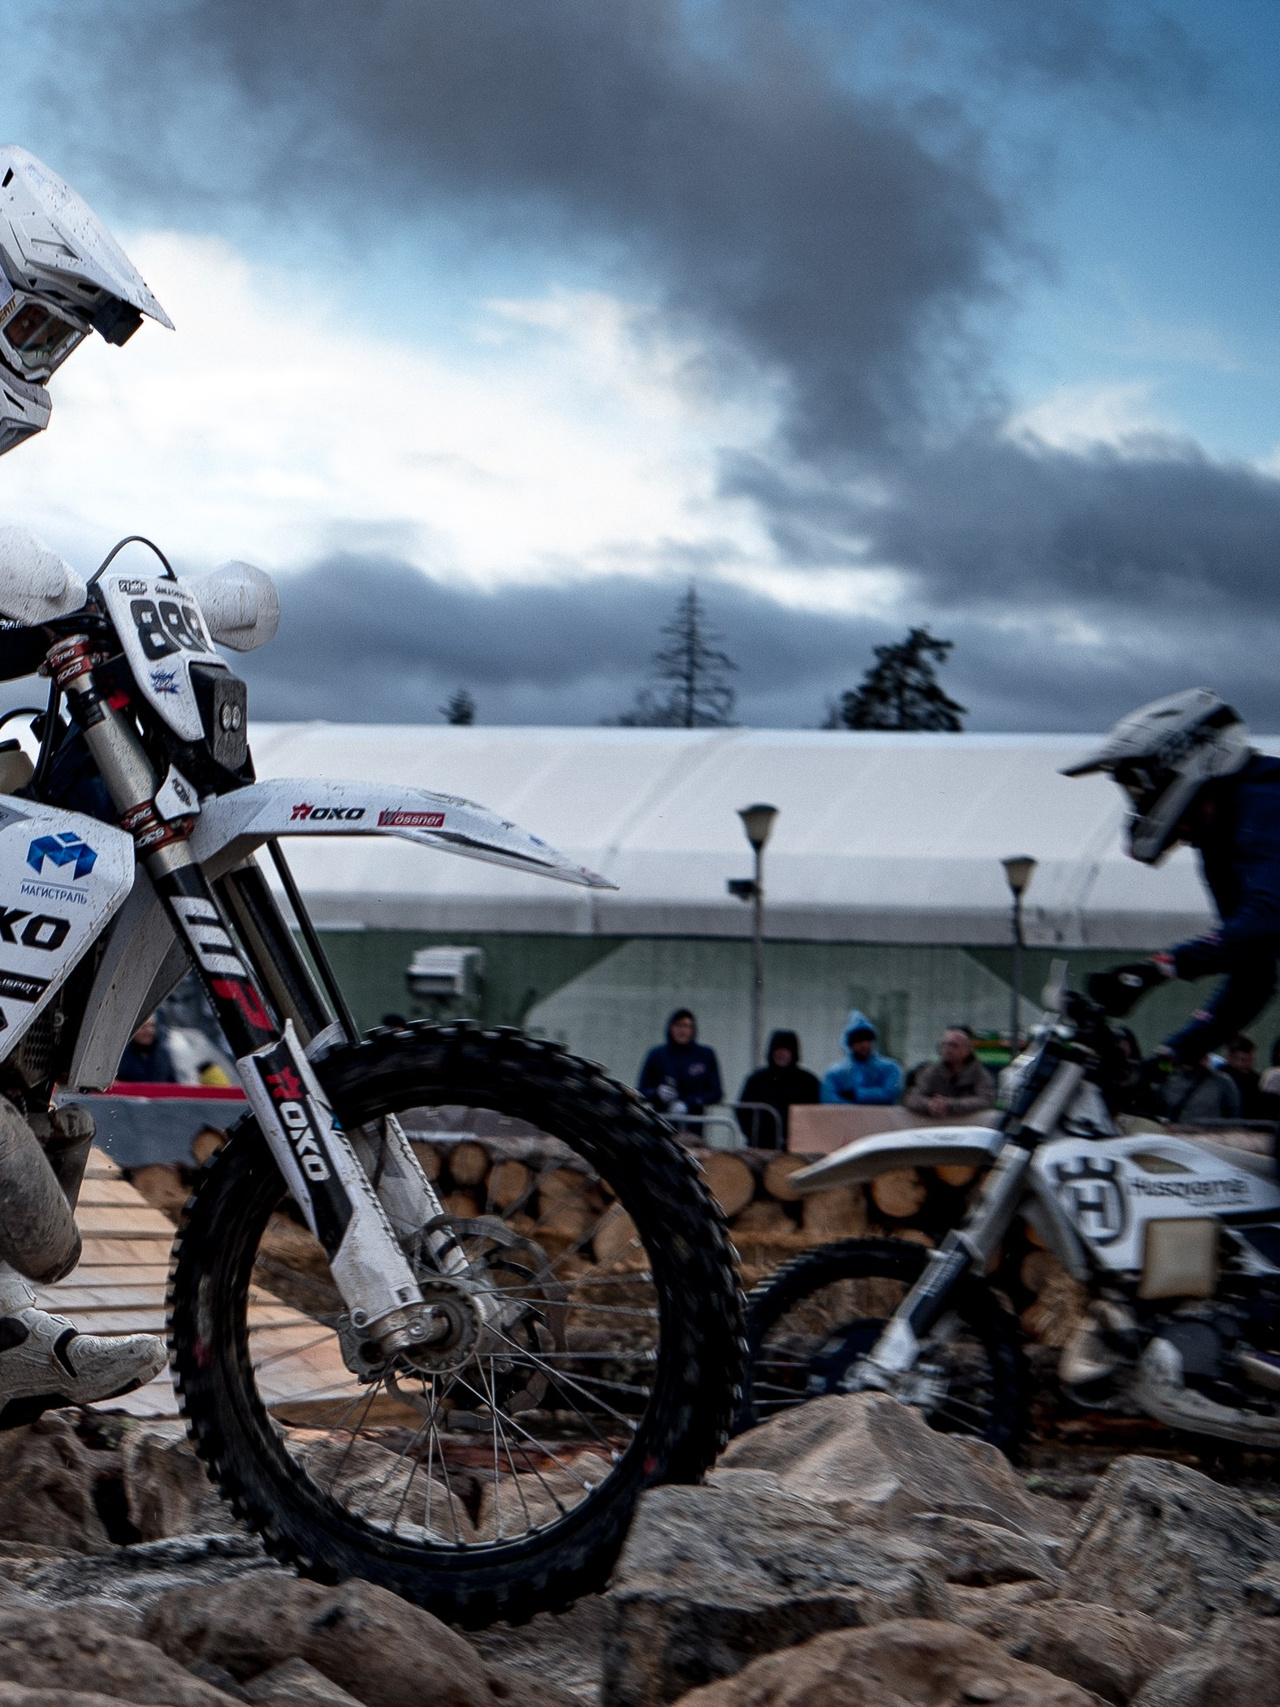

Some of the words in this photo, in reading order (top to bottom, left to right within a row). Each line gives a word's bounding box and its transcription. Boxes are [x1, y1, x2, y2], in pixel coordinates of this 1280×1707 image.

[129, 599, 215, 662] 888
[289, 802, 367, 822] ROKO
[20, 882, 88, 905] МАГИСТРАЛЬ
[266, 1066, 331, 1182] ROKO
